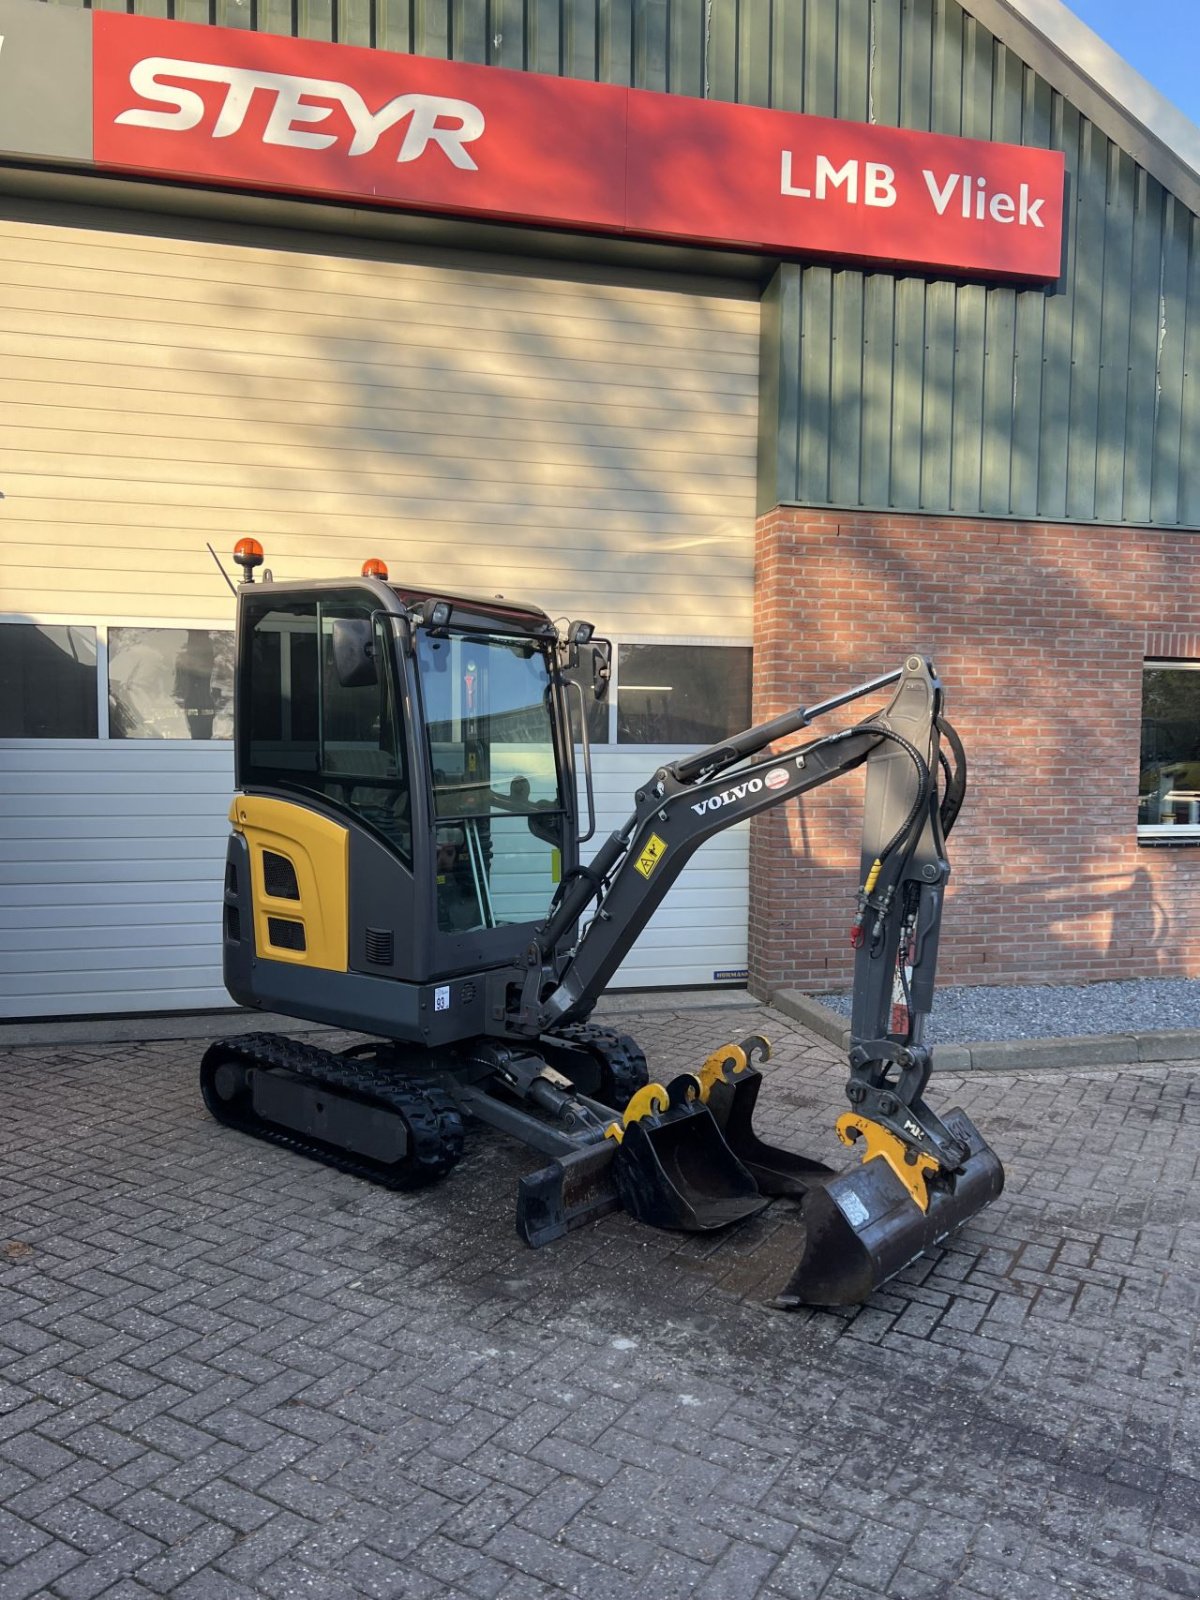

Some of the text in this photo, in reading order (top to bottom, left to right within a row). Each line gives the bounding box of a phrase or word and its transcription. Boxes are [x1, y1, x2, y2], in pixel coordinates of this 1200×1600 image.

[114, 57, 486, 171] STEYR
[780, 150, 1046, 228] LMB Vliek
[690, 778, 763, 816] VOLVO
